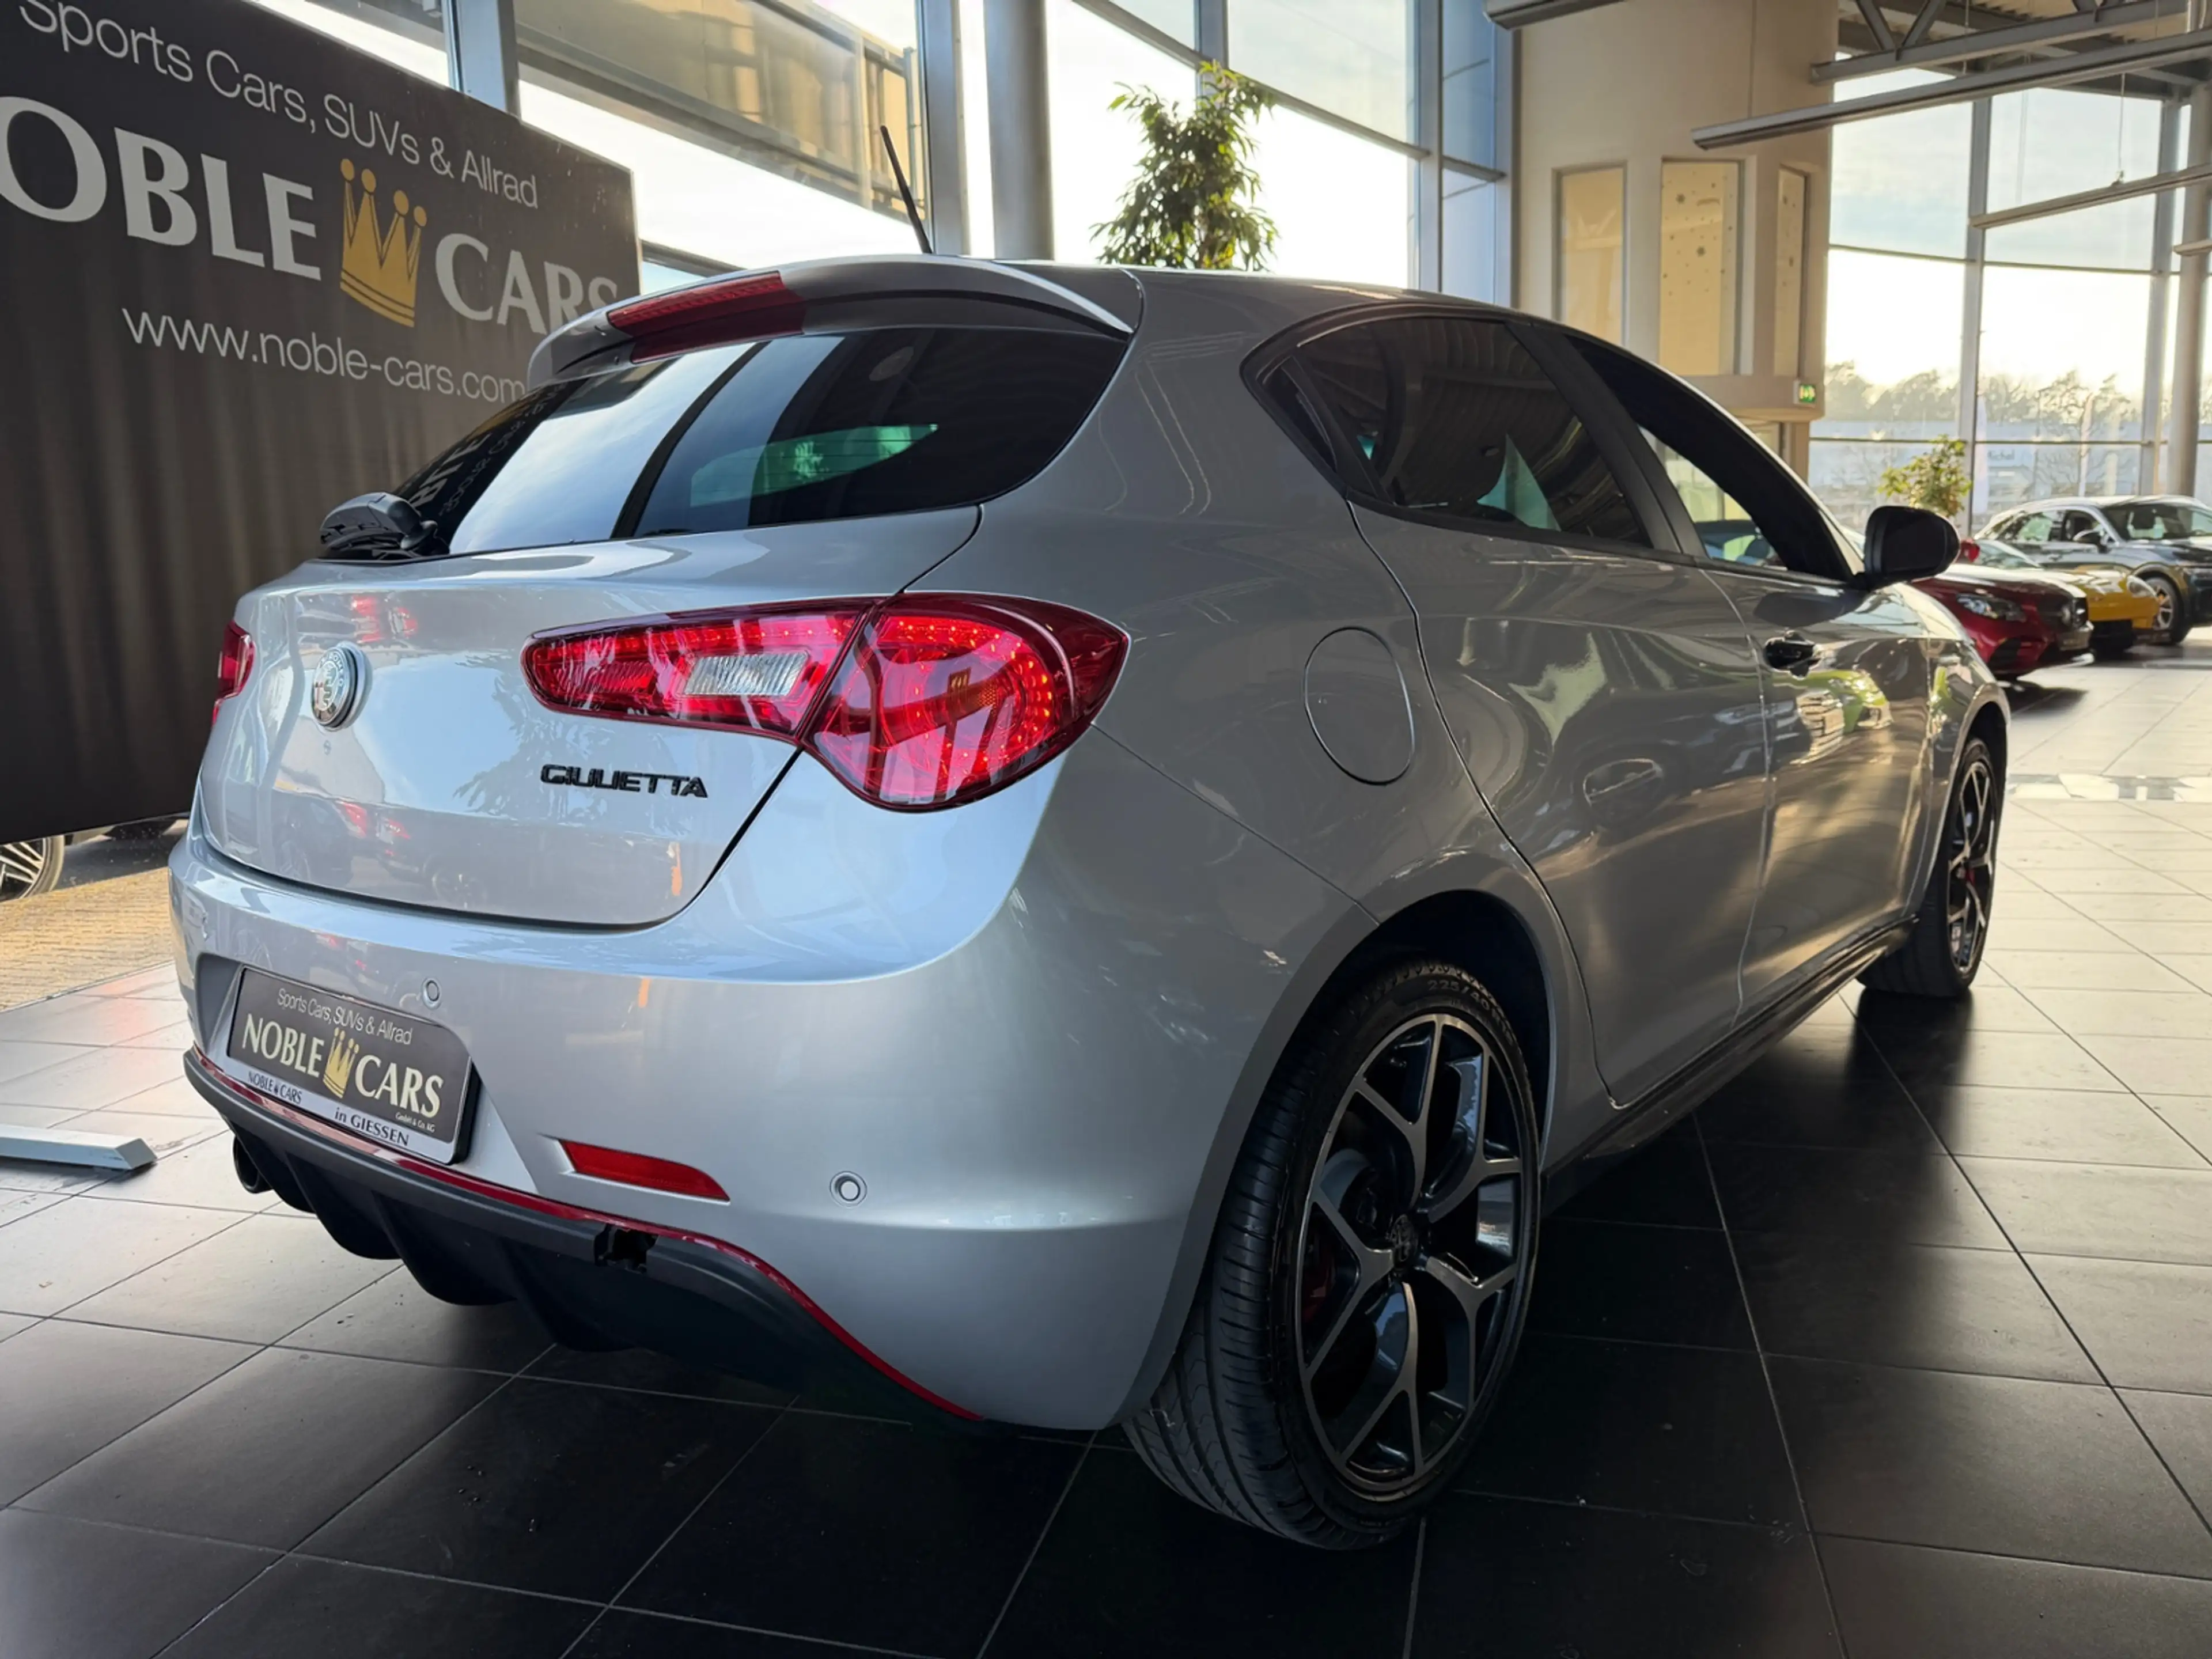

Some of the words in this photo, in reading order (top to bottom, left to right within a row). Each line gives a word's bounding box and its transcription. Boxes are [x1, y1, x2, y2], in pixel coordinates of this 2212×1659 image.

[19, 0, 194, 82] Sports
[206, 50, 316, 133] Cars,
[323, 93, 420, 165] SUVs
[430, 137, 455, 179] &
[461, 150, 539, 209] Allrad
[0, 96, 322, 281] OBLE
[122, 308, 525, 403] www.noble-cars.com
[540, 763, 709, 798] GIULIETTA
[277, 988, 308, 1013] Sports
[308, 998, 332, 1025] Cars,
[333, 1006, 365, 1032] SUVs
[365, 1017, 375, 1035] &
[377, 1019, 413, 1045] Allrad
[242, 1013, 325, 1078] NOBLE
[355, 1055, 444, 1118] CARS
[248, 1070, 274, 1092] NOBLE
[279, 1084, 302, 1104] CARS
[335, 1107, 346, 1123] in
[350, 1114, 410, 1146] GIESSEN
